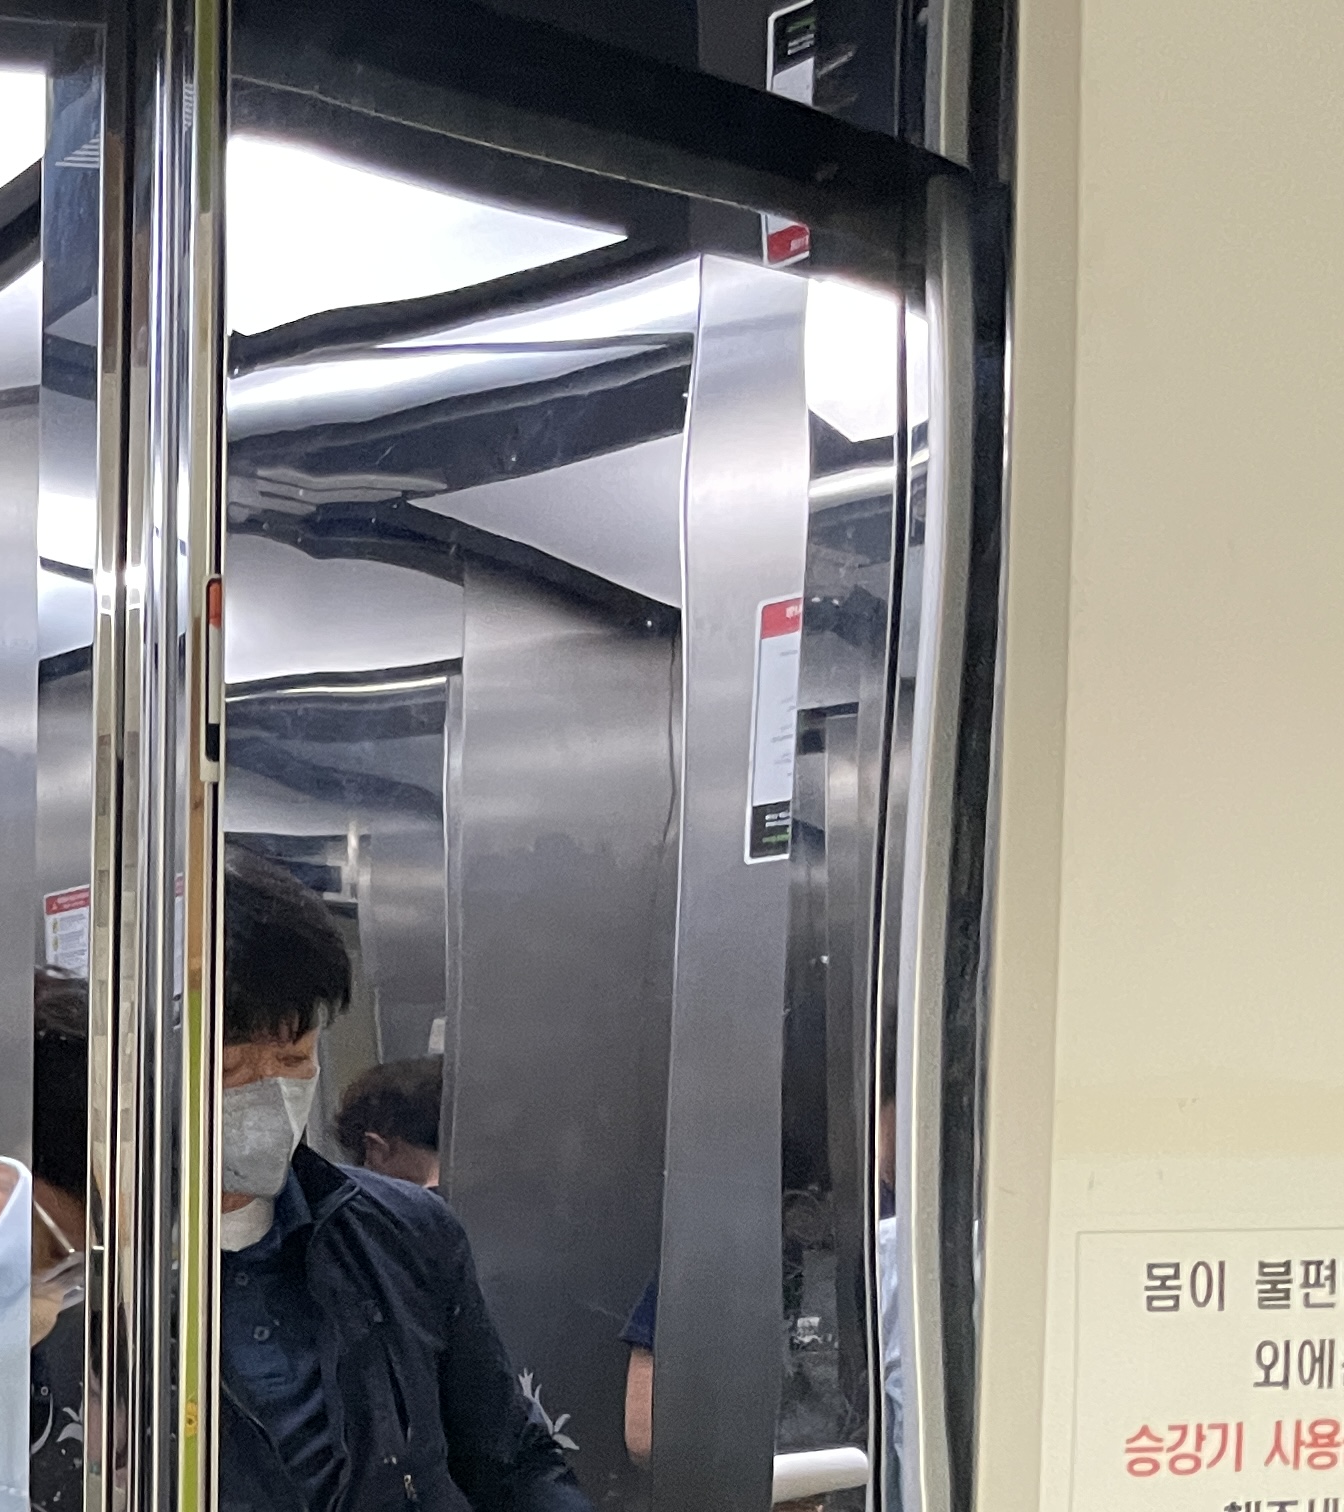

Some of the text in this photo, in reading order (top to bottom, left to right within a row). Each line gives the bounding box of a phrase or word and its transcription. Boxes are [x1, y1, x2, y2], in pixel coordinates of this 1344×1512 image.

[1144, 1258, 1337, 1312] 몸이 불편
[1253, 1338, 1344, 1391] 외에
[1125, 1418, 1344, 1477] 승강기 사용
